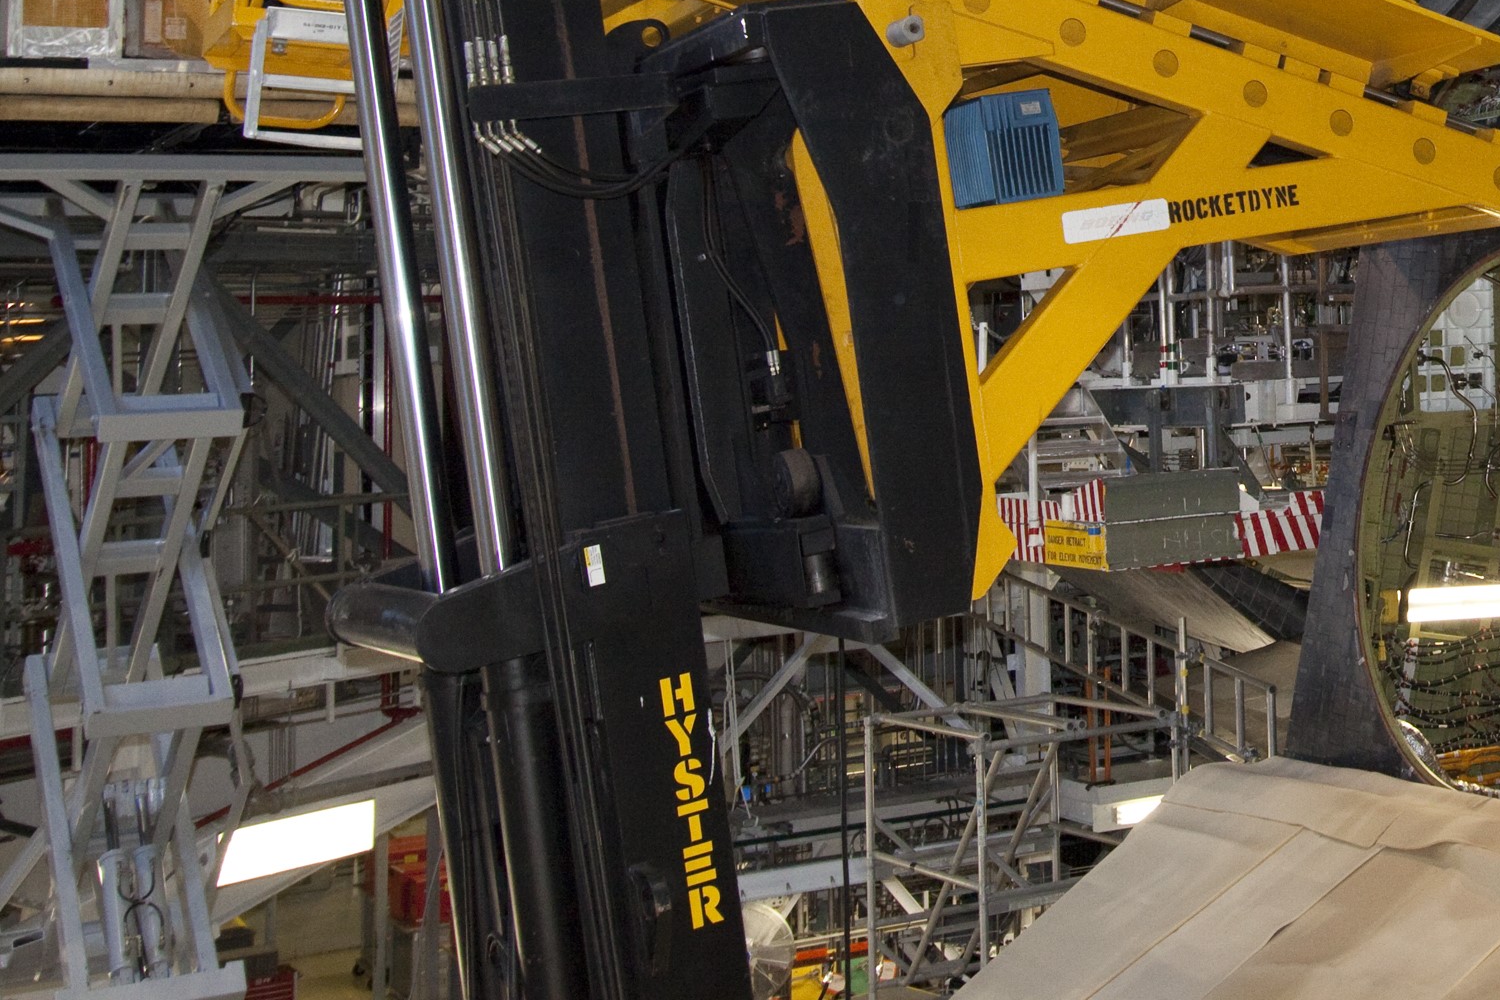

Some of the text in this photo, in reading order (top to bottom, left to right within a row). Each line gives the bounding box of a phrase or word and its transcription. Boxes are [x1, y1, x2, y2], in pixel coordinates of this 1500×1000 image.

[1168, 184, 1301, 224] ROCKETDYNE
[1066, 536, 1086, 547] RETRACT
[1047, 551, 1057, 560] FOR
[659, 671, 726, 931] HYSTER
